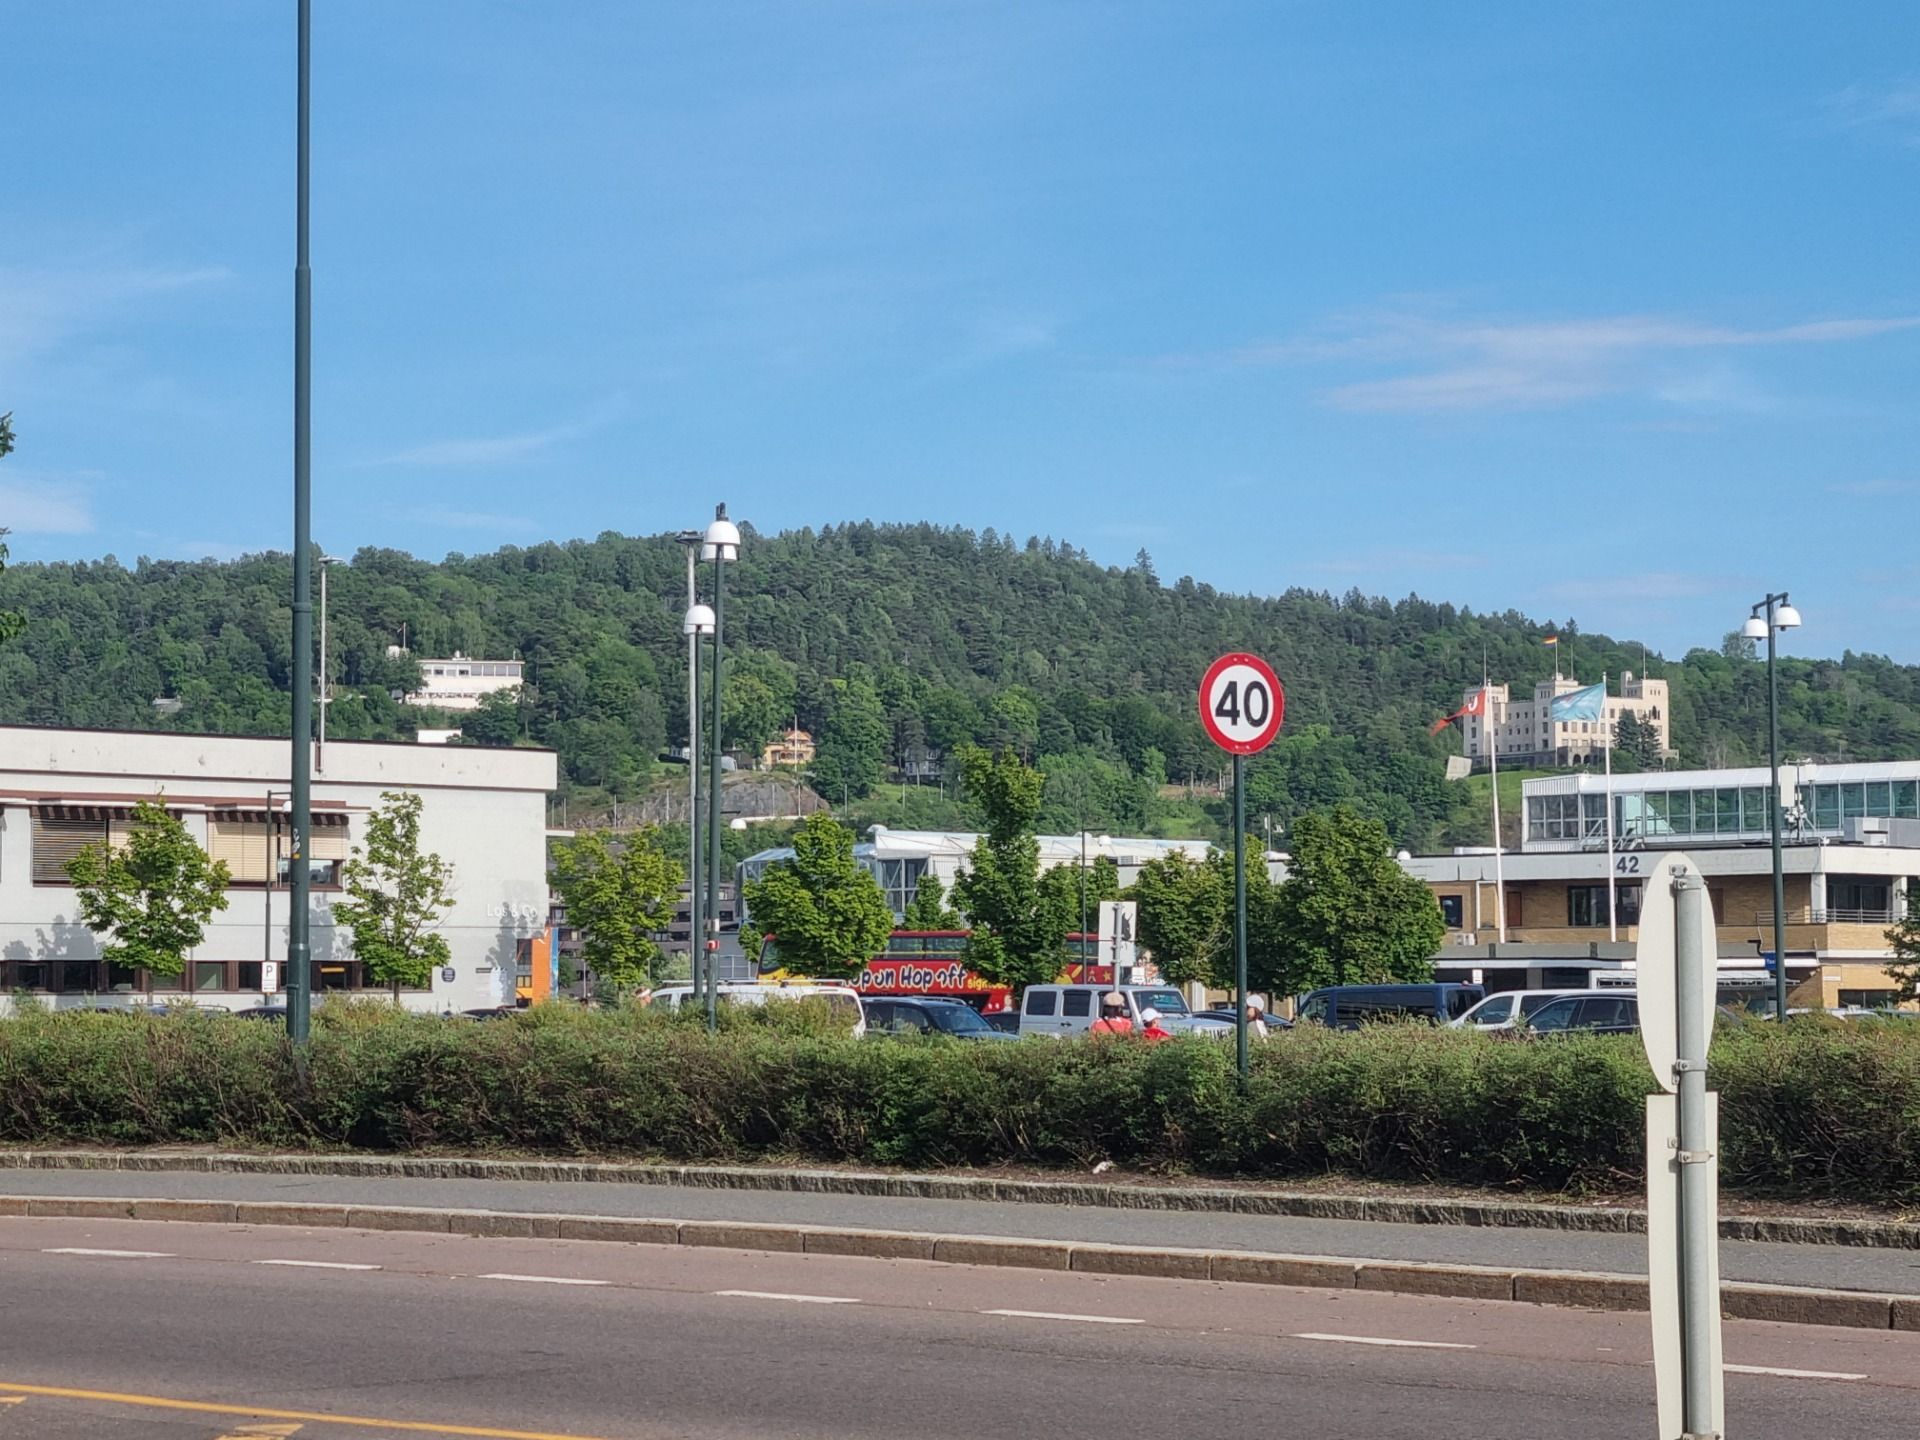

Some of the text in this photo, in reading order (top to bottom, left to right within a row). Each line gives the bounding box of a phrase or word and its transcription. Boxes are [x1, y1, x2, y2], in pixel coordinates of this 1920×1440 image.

[1215, 681, 1269, 728] 40
[1616, 856, 1640, 873] 42
[487, 903, 508, 917] Los
[511, 904, 519, 917] &
[266, 965, 273, 977] P
[841, 969, 873, 993] op
[872, 968, 896, 989] on
[899, 964, 934, 993] Hop
[935, 962, 968, 989] off
